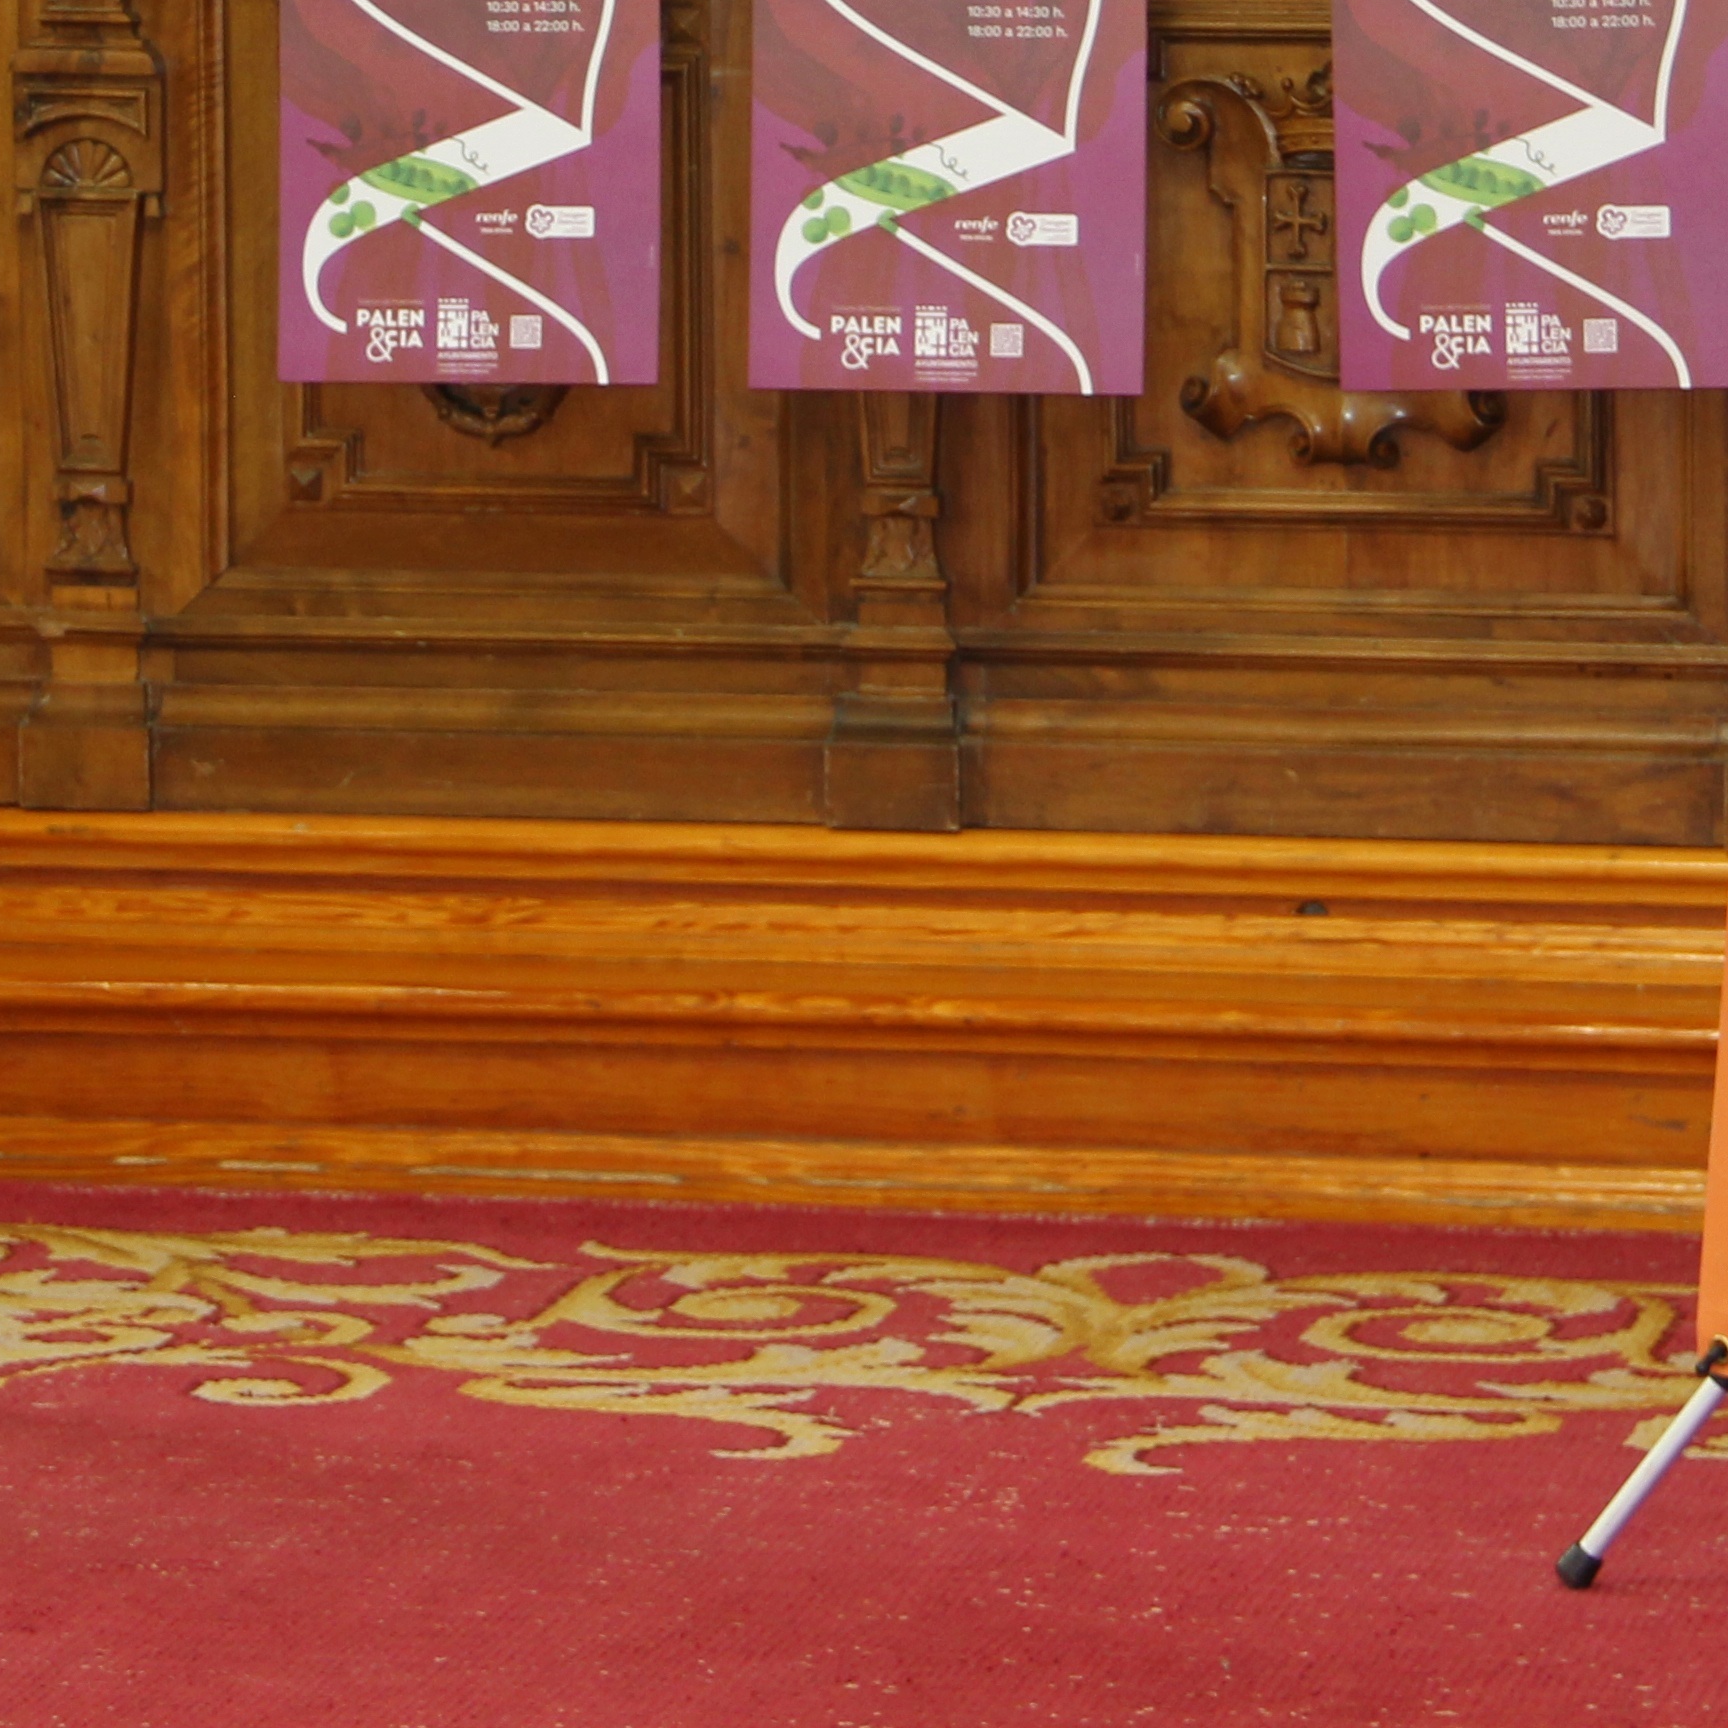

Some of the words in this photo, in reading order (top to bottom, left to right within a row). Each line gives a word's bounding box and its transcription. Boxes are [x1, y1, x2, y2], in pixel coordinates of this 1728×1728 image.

[486, 1, 519, 13] 10:30
[522, 4, 530, 13] a
[533, 1, 566, 13] 14:30
[1589, 0, 1598, 8] a
[967, 6, 1001, 18] 10:30
[1004, 9, 1013, 18] a
[1015, 6, 1050, 18] 14:30
[523, 23, 531, 32] a
[1589, 19, 1599, 28] a
[1004, 29, 1013, 38] a
[356, 308, 425, 327] PALEN
[471, 310, 490, 322] PA
[1541, 314, 1561, 326] PA
[471, 323, 500, 336] LEN
[830, 315, 902, 334] PALEN
[950, 318, 969, 331] PA
[1420, 315, 1492, 333] PALEN
[950, 331, 979, 345] LEN
[1541, 327, 1571, 340] LEN
[470, 336, 496, 349] CIA
[1541, 340, 1569, 353] CIA
[949, 345, 975, 357] CIA
